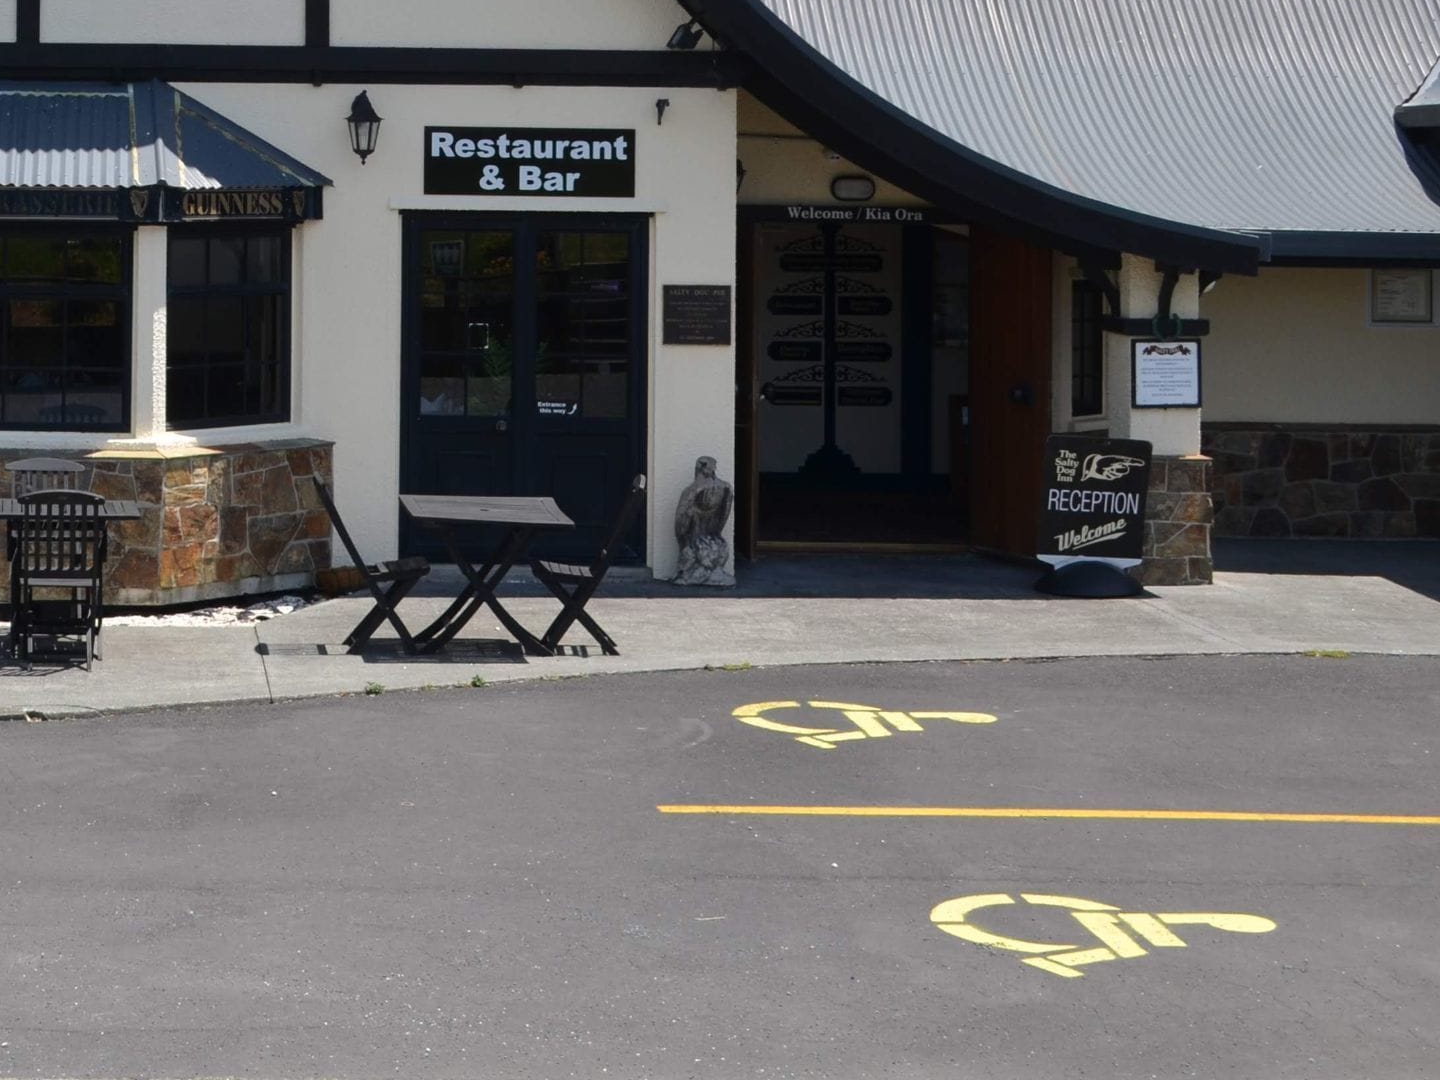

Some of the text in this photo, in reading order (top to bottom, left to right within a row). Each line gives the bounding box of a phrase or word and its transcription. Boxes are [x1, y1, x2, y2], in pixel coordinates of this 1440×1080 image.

[431, 131, 628, 160] Restaurant
[479, 165, 581, 192] & Bar
[182, 190, 284, 216] GUINNESS
[787, 206, 854, 220] Welcome
[864, 207, 891, 220] Kia
[895, 208, 923, 221] Ora
[1054, 457, 1080, 468] Salty
[1059, 449, 1078, 459] The
[1056, 465, 1076, 477] Dog
[1056, 473, 1073, 483] Inn
[1047, 488, 1140, 515] RECEPTION
[1053, 518, 1128, 552] Welcome
